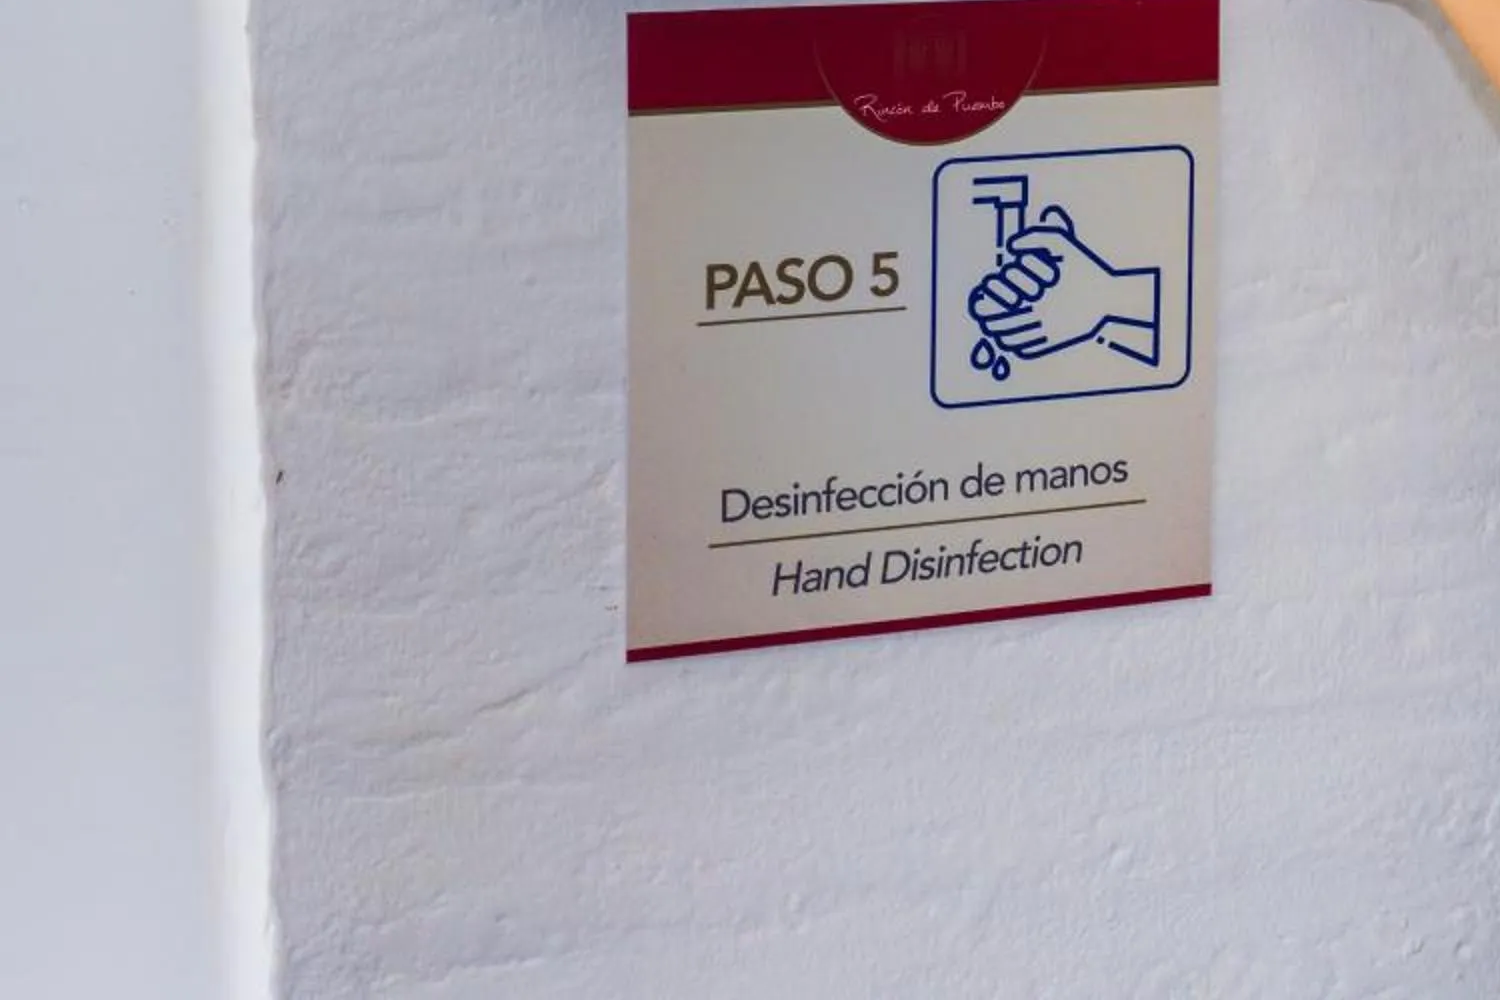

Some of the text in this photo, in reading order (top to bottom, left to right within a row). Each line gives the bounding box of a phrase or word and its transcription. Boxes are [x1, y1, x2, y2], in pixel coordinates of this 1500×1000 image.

[921, 100, 941, 113] de
[706, 251, 900, 310] PASO 5
[721, 459, 1129, 523] Desinfección de manos
[772, 536, 1083, 596] Hand Disinfection
